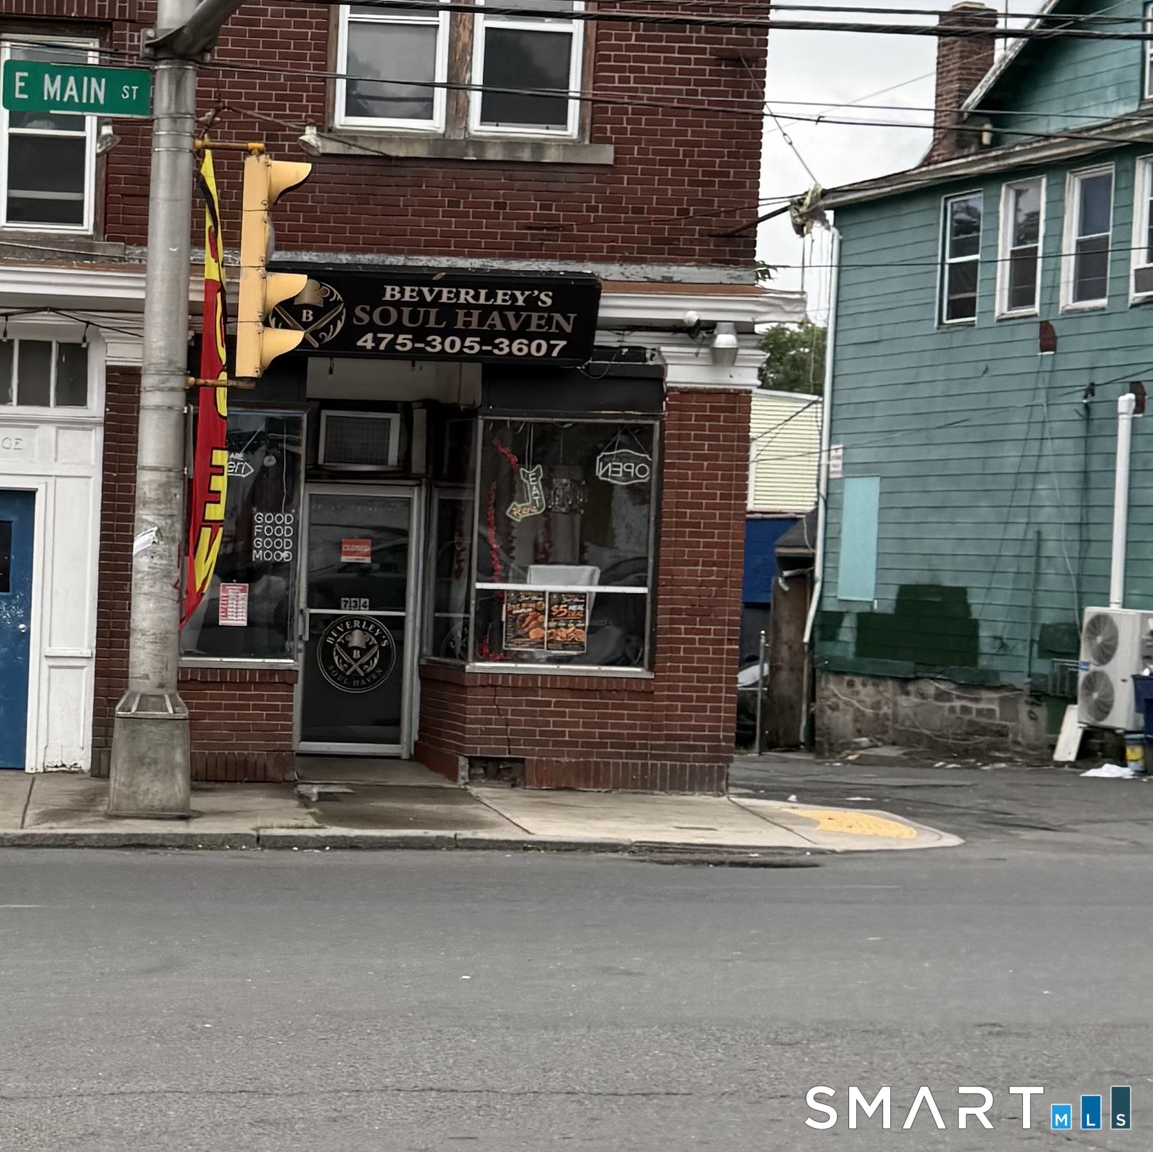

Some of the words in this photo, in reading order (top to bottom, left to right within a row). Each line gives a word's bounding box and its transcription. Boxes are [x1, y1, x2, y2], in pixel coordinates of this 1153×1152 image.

[14, 71, 29, 99] E
[43, 73, 106, 105] MAIN
[121, 85, 139, 100] ST
[382, 285, 554, 308] BEVERLEY'S
[300, 309, 314, 323] B
[352, 304, 447, 329] SOUL
[453, 309, 578, 334] HAVEN
[356, 332, 568, 358] 475-305-3607
[528, 472, 541, 509] EAT
[254, 512, 294, 525] GOOD
[254, 525, 294, 537] FOOD
[253, 537, 293, 550] GOOD
[252, 549, 293, 562] MOOD
[342, 599, 369, 609] 734
[326, 619, 389, 647] BEVERLEY'S
